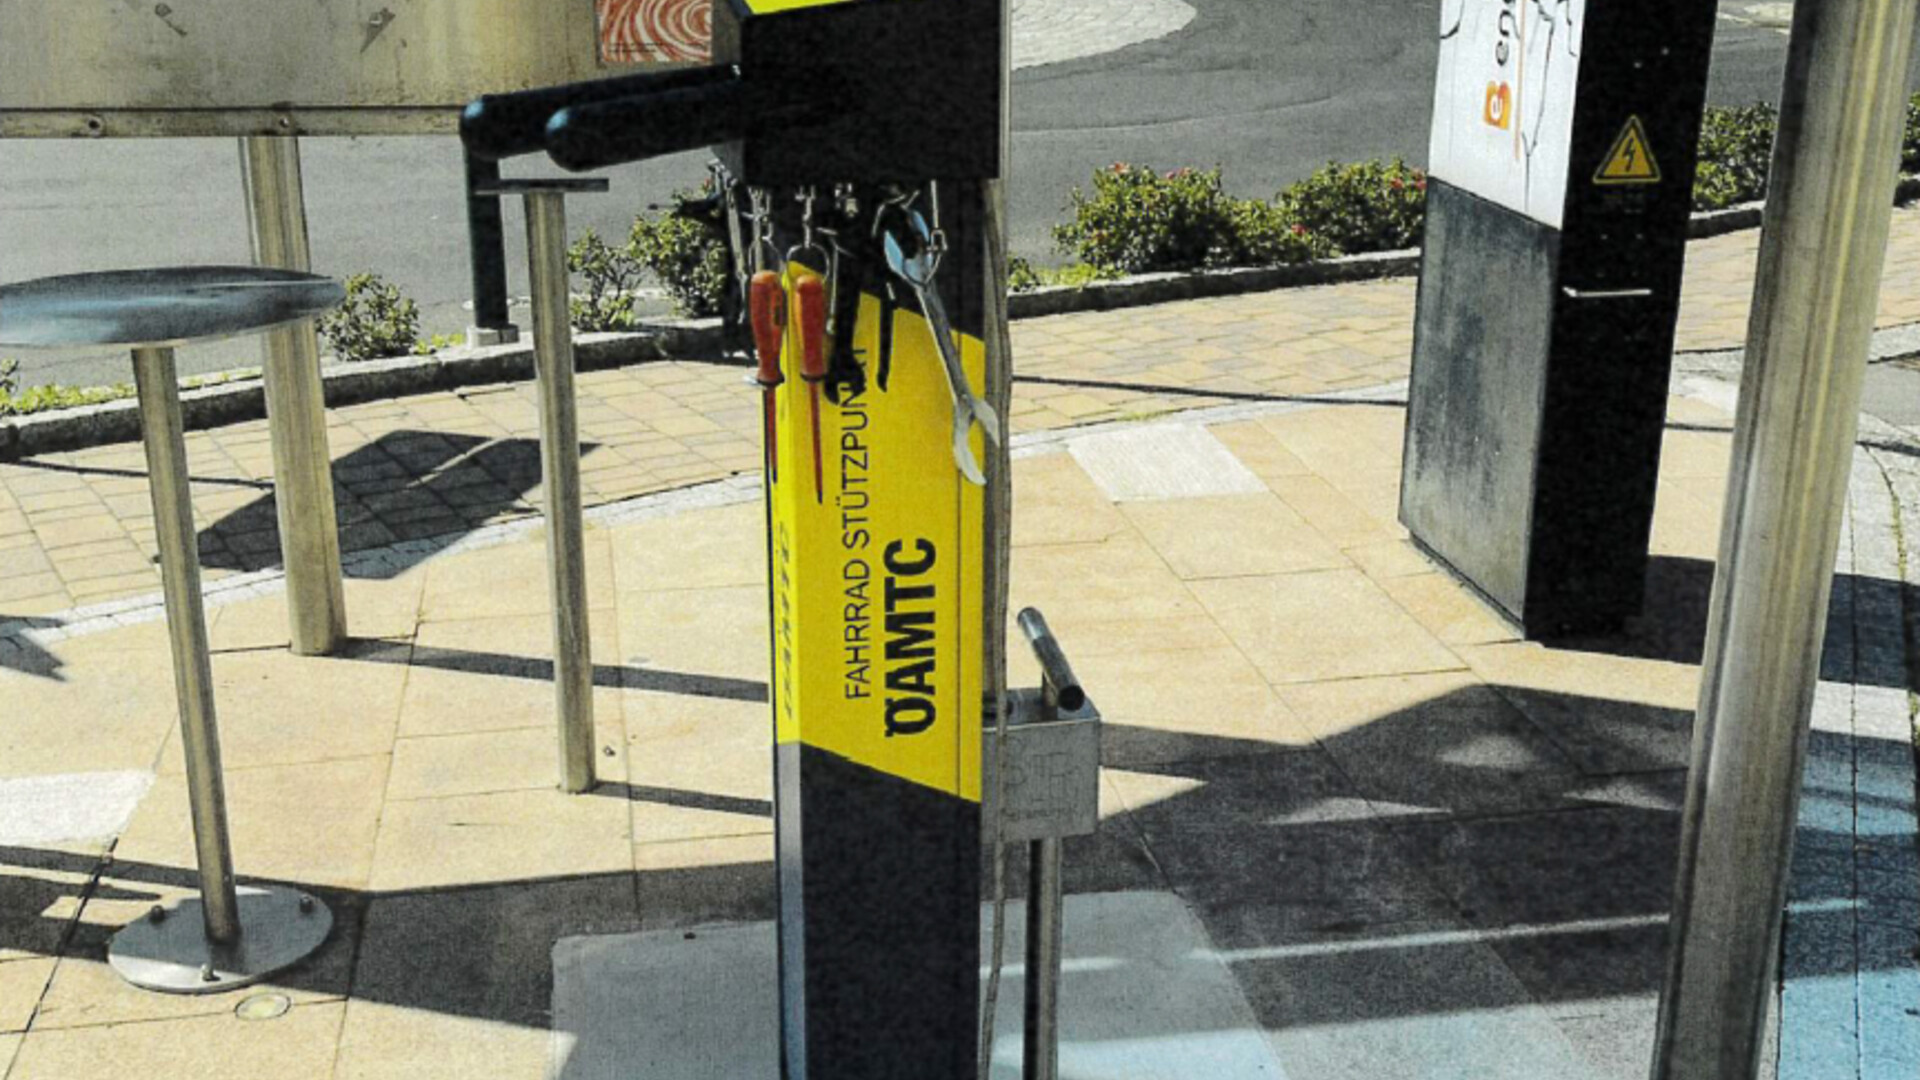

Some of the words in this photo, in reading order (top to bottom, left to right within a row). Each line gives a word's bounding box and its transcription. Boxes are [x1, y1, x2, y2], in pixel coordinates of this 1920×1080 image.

[1495, 0, 1516, 67] en
[835, 347, 870, 549] STÜTZPUN
[843, 559, 871, 699] FAHRRAD
[884, 538, 936, 737] ÖAMTC
